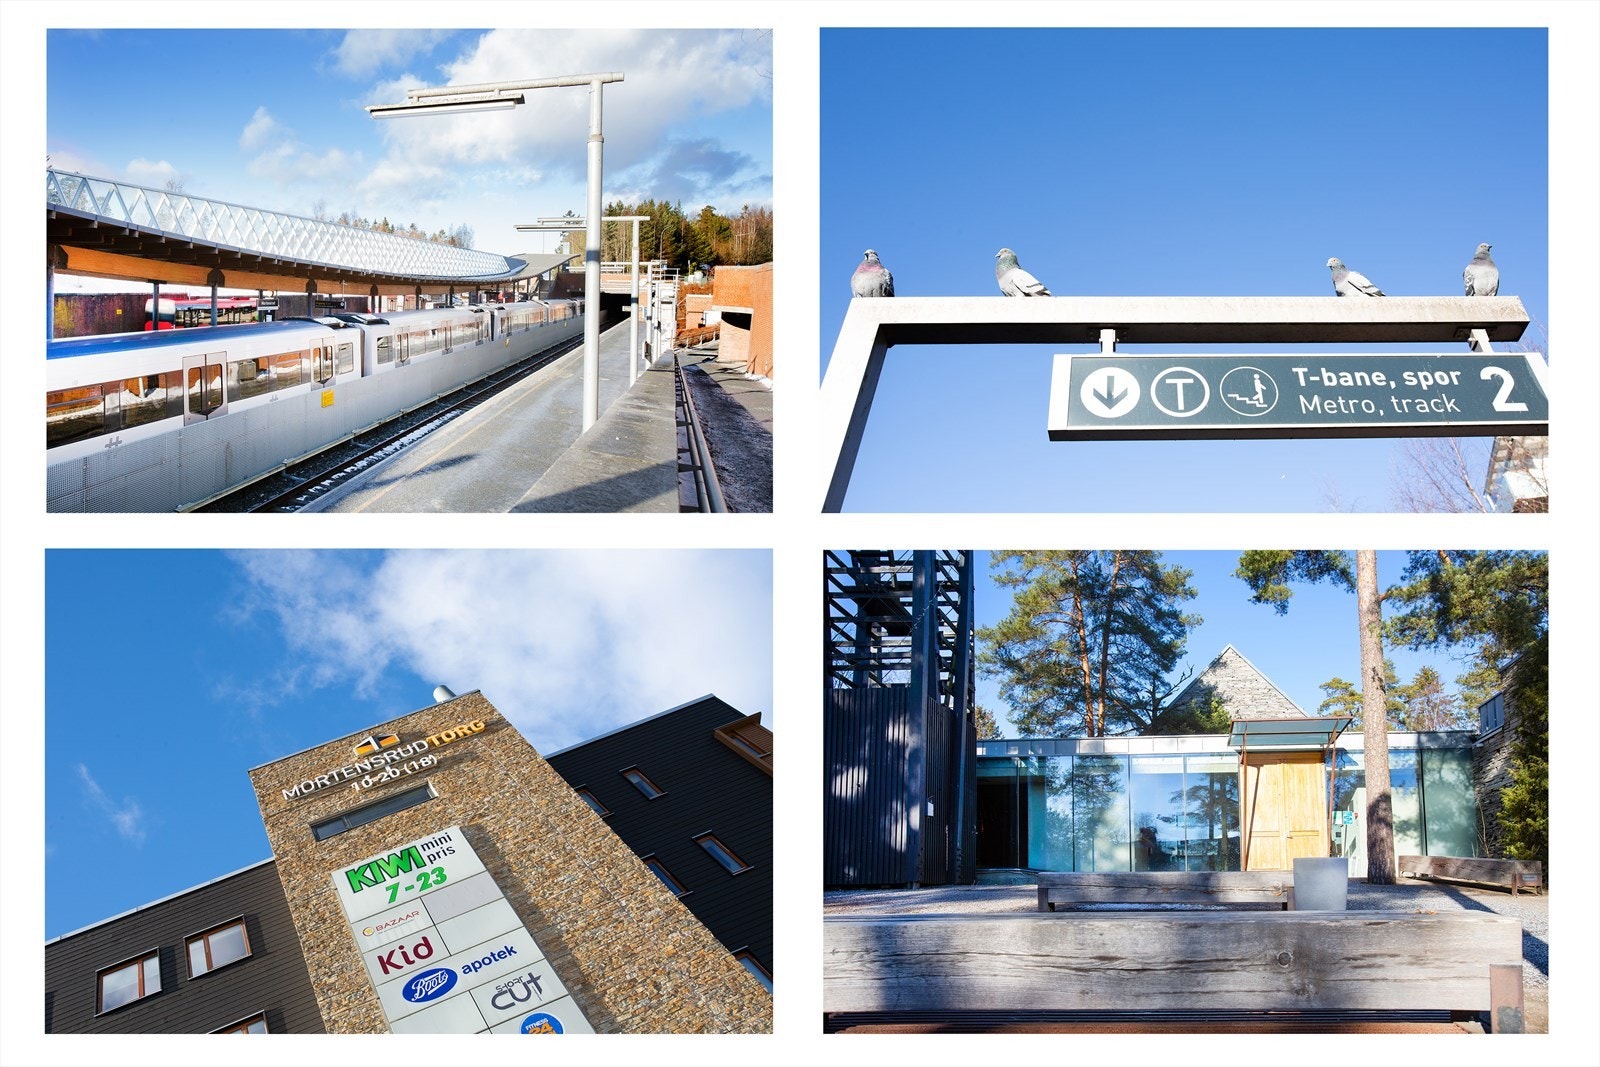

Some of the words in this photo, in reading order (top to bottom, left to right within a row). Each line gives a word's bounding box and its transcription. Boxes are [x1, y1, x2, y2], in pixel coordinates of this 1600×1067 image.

[1292, 367, 1396, 389] T-bane,
[1402, 369, 1461, 390] spor
[1480, 366, 1529, 412] 2
[1300, 395, 1384, 416] Metro,
[1391, 394, 1462, 413] track
[421, 832, 453, 852] mini
[427, 845, 456, 864] pris
[345, 845, 427, 893] KIWI
[375, 910, 420, 931] BAZAAR
[377, 936, 434, 975] Kid
[411, 969, 449, 1001] Boots
[461, 945, 518, 975] apotek
